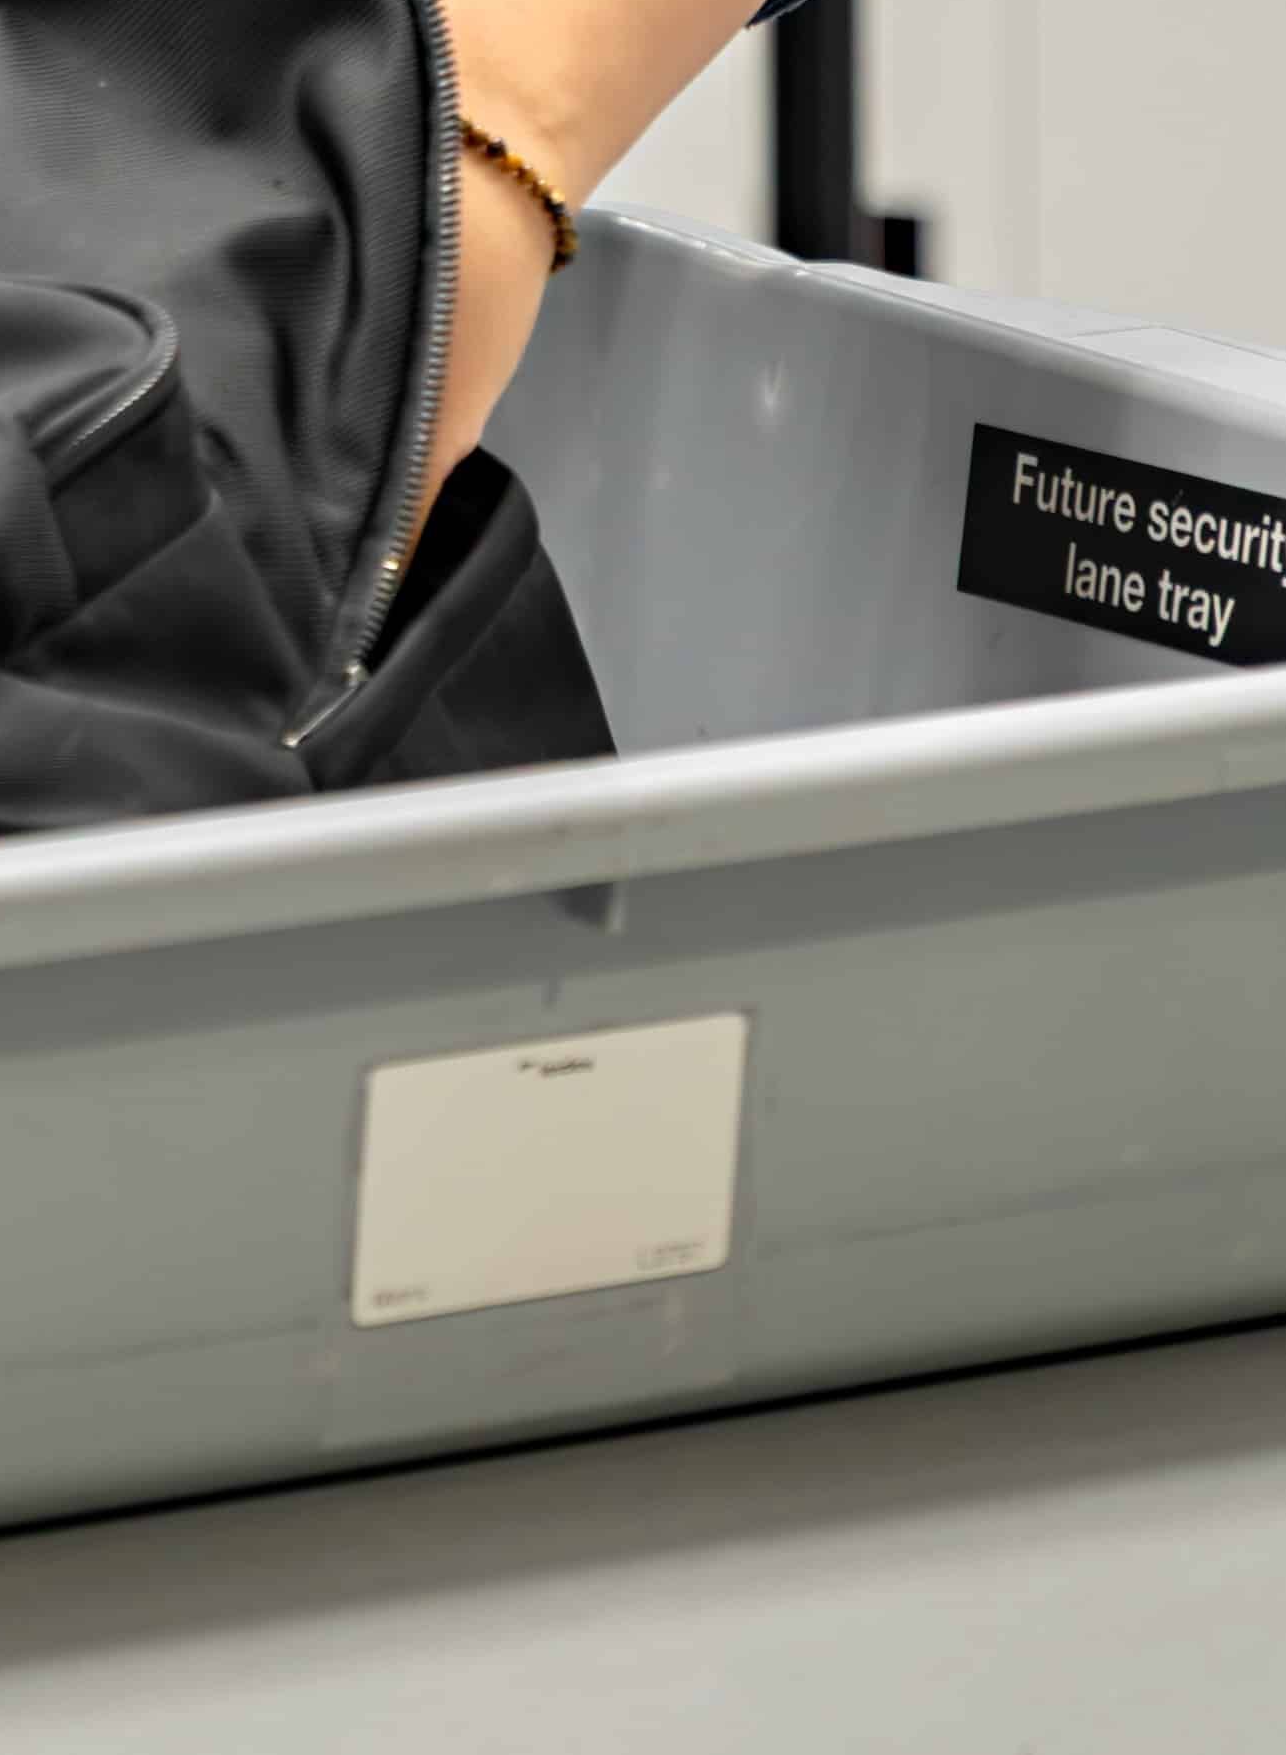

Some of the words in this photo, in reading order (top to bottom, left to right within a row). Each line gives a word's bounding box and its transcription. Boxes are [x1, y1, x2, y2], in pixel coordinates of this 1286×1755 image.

[1012, 451, 1137, 534] Future
[1063, 541, 1146, 613] lane
[1157, 569, 1236, 648] tray
